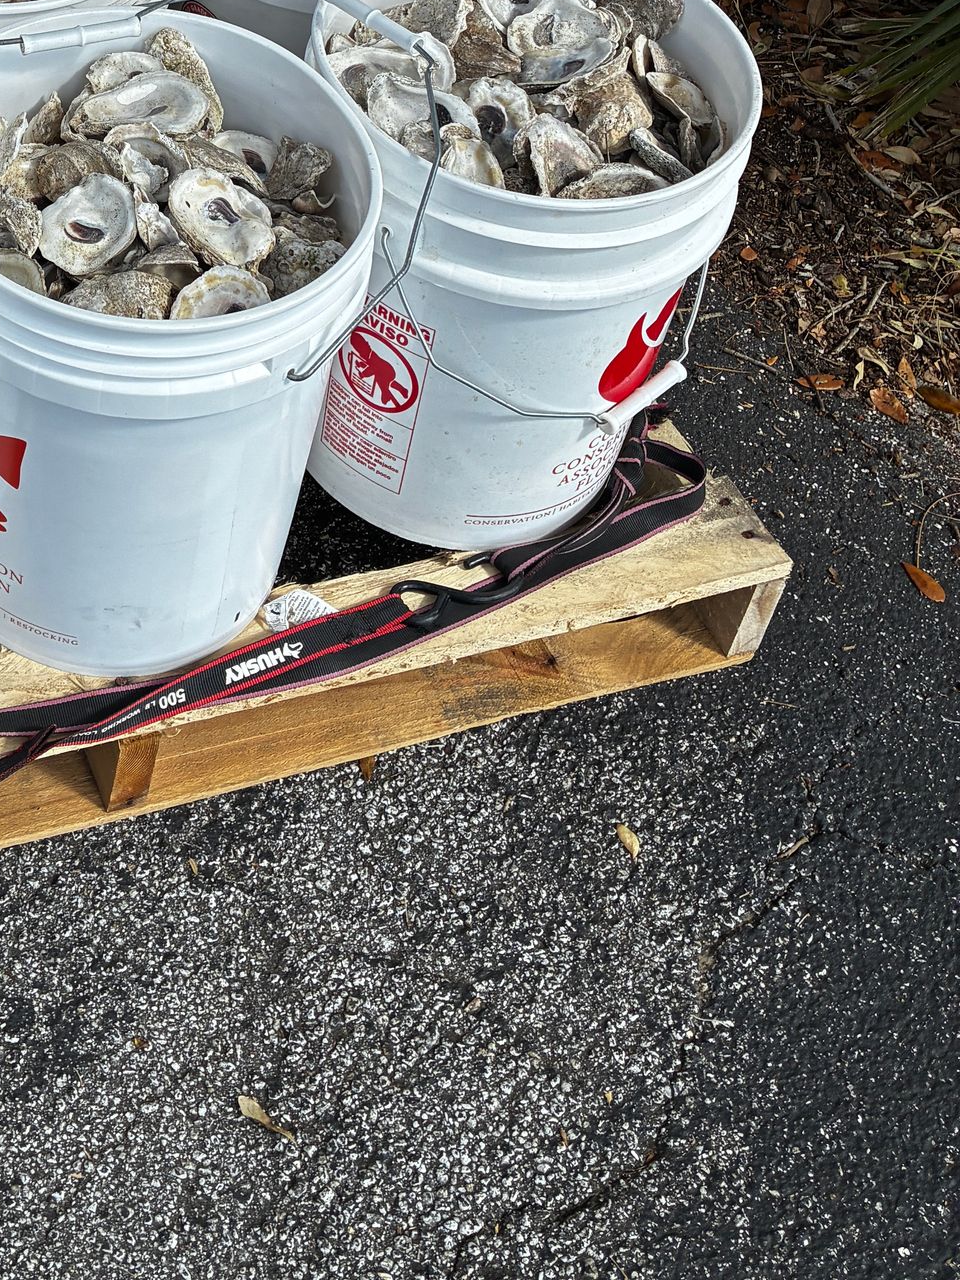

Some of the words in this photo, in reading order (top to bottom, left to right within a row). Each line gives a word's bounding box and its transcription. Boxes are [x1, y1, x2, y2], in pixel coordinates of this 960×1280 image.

[552, 419, 631, 476] CONSER
[557, 434, 624, 488] ASSOCI
[575, 448, 618, 493] FLOR
[9, 616, 80, 647] RESTOCKING
[225, 648, 287, 686] HUSKY
[158, 687, 187, 710] 500
[100, 708, 142, 734] WORKING
